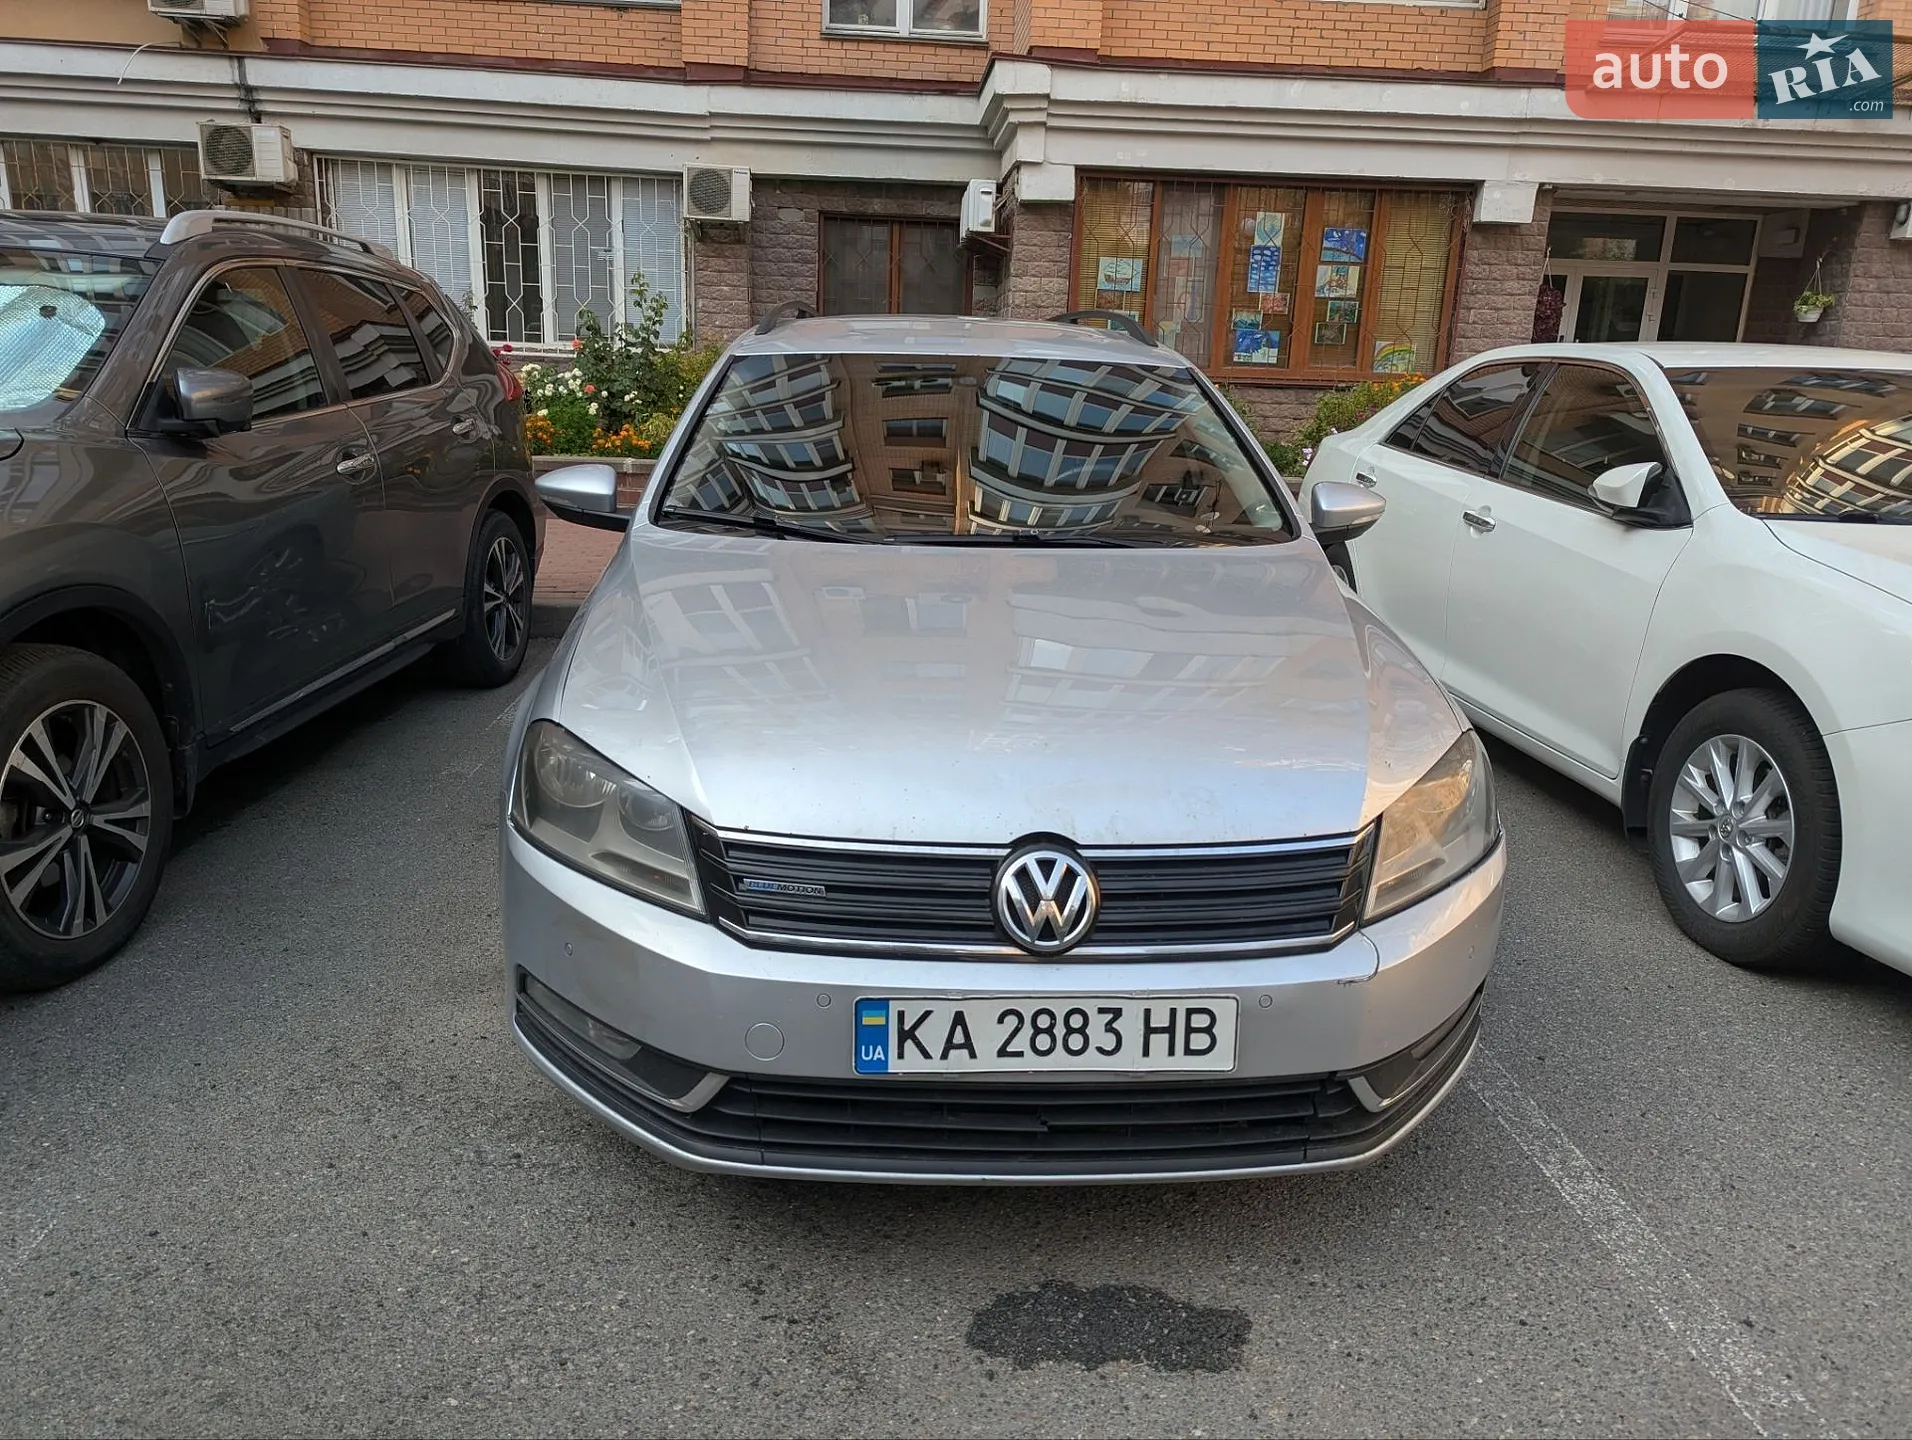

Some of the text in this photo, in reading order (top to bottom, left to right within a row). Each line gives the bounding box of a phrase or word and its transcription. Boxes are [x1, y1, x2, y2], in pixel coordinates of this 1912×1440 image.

[896, 1006, 1218, 1061] KA 2883 HB
[861, 1045, 885, 1061] UA
